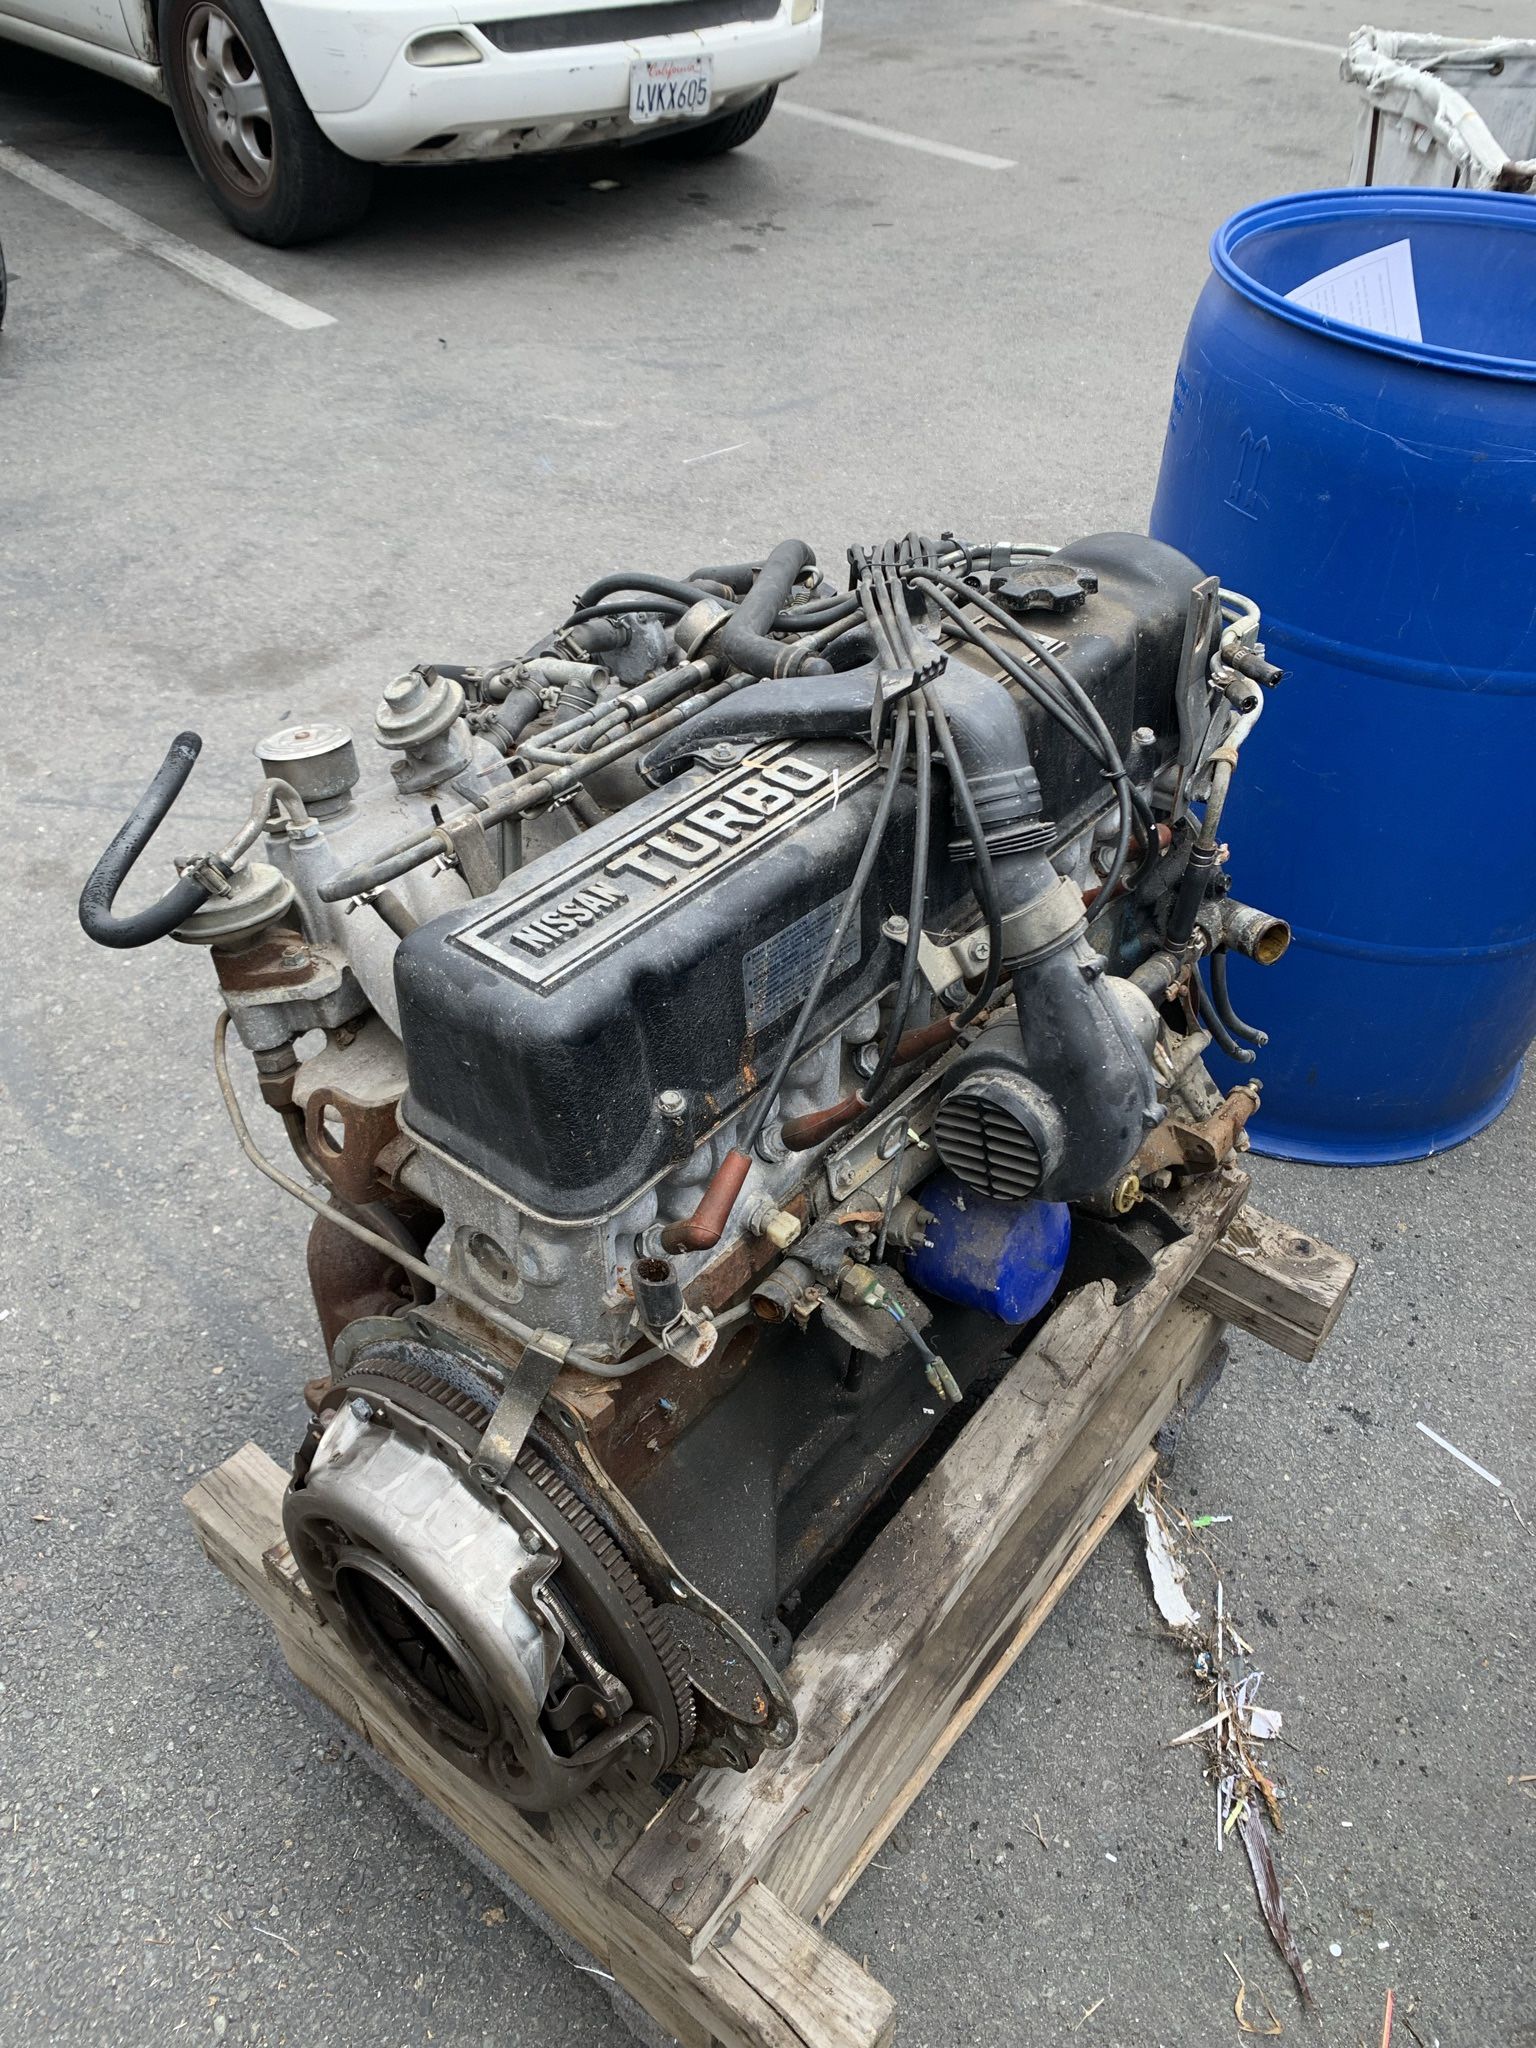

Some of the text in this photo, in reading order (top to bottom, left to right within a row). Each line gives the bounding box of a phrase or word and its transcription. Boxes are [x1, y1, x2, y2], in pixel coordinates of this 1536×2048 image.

[648, 62, 699, 79] California
[635, 78, 707, 112] 4VKX605
[510, 757, 829, 957] NISSAN TURBO
